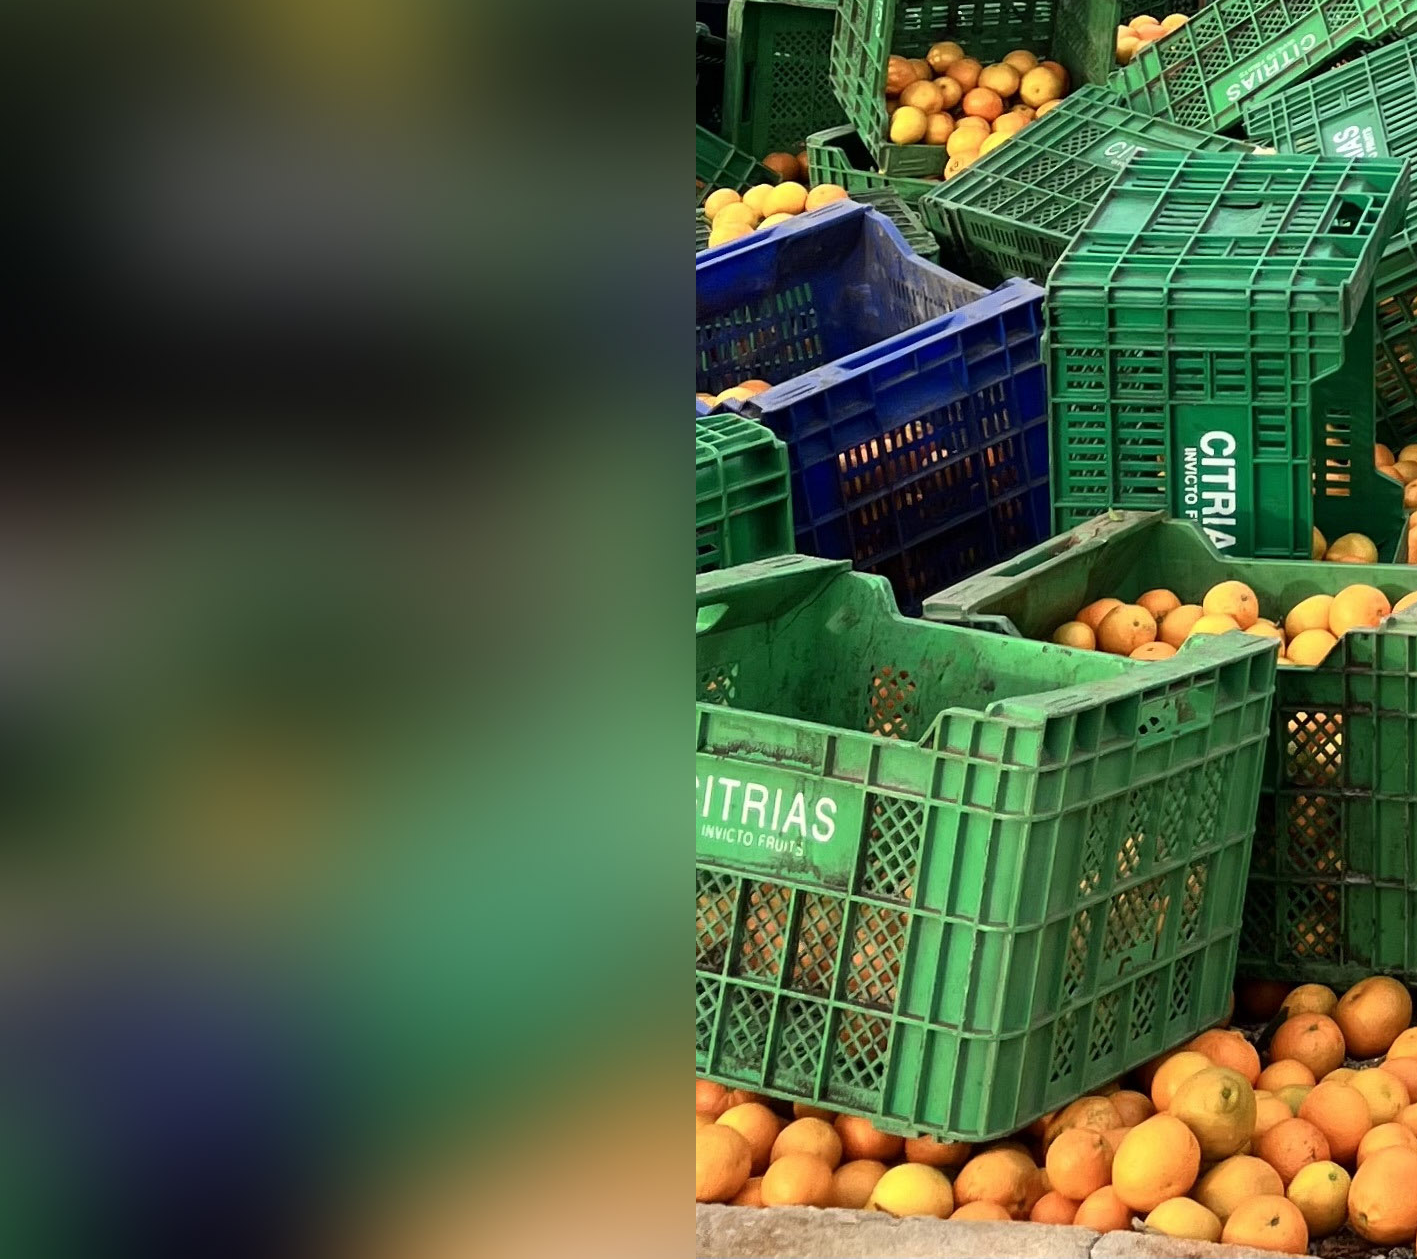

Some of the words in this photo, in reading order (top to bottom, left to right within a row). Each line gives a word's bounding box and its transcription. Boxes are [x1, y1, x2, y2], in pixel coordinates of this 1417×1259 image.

[1226, 33, 1316, 102] CITRIAS
[1184, 447, 1198, 505] INVICTO
[1200, 431, 1236, 558] CITRIA
[696, 774, 837, 842] ITRIAS
[702, 824, 754, 846] INVICTO
[758, 834, 804, 857] FRUITS
